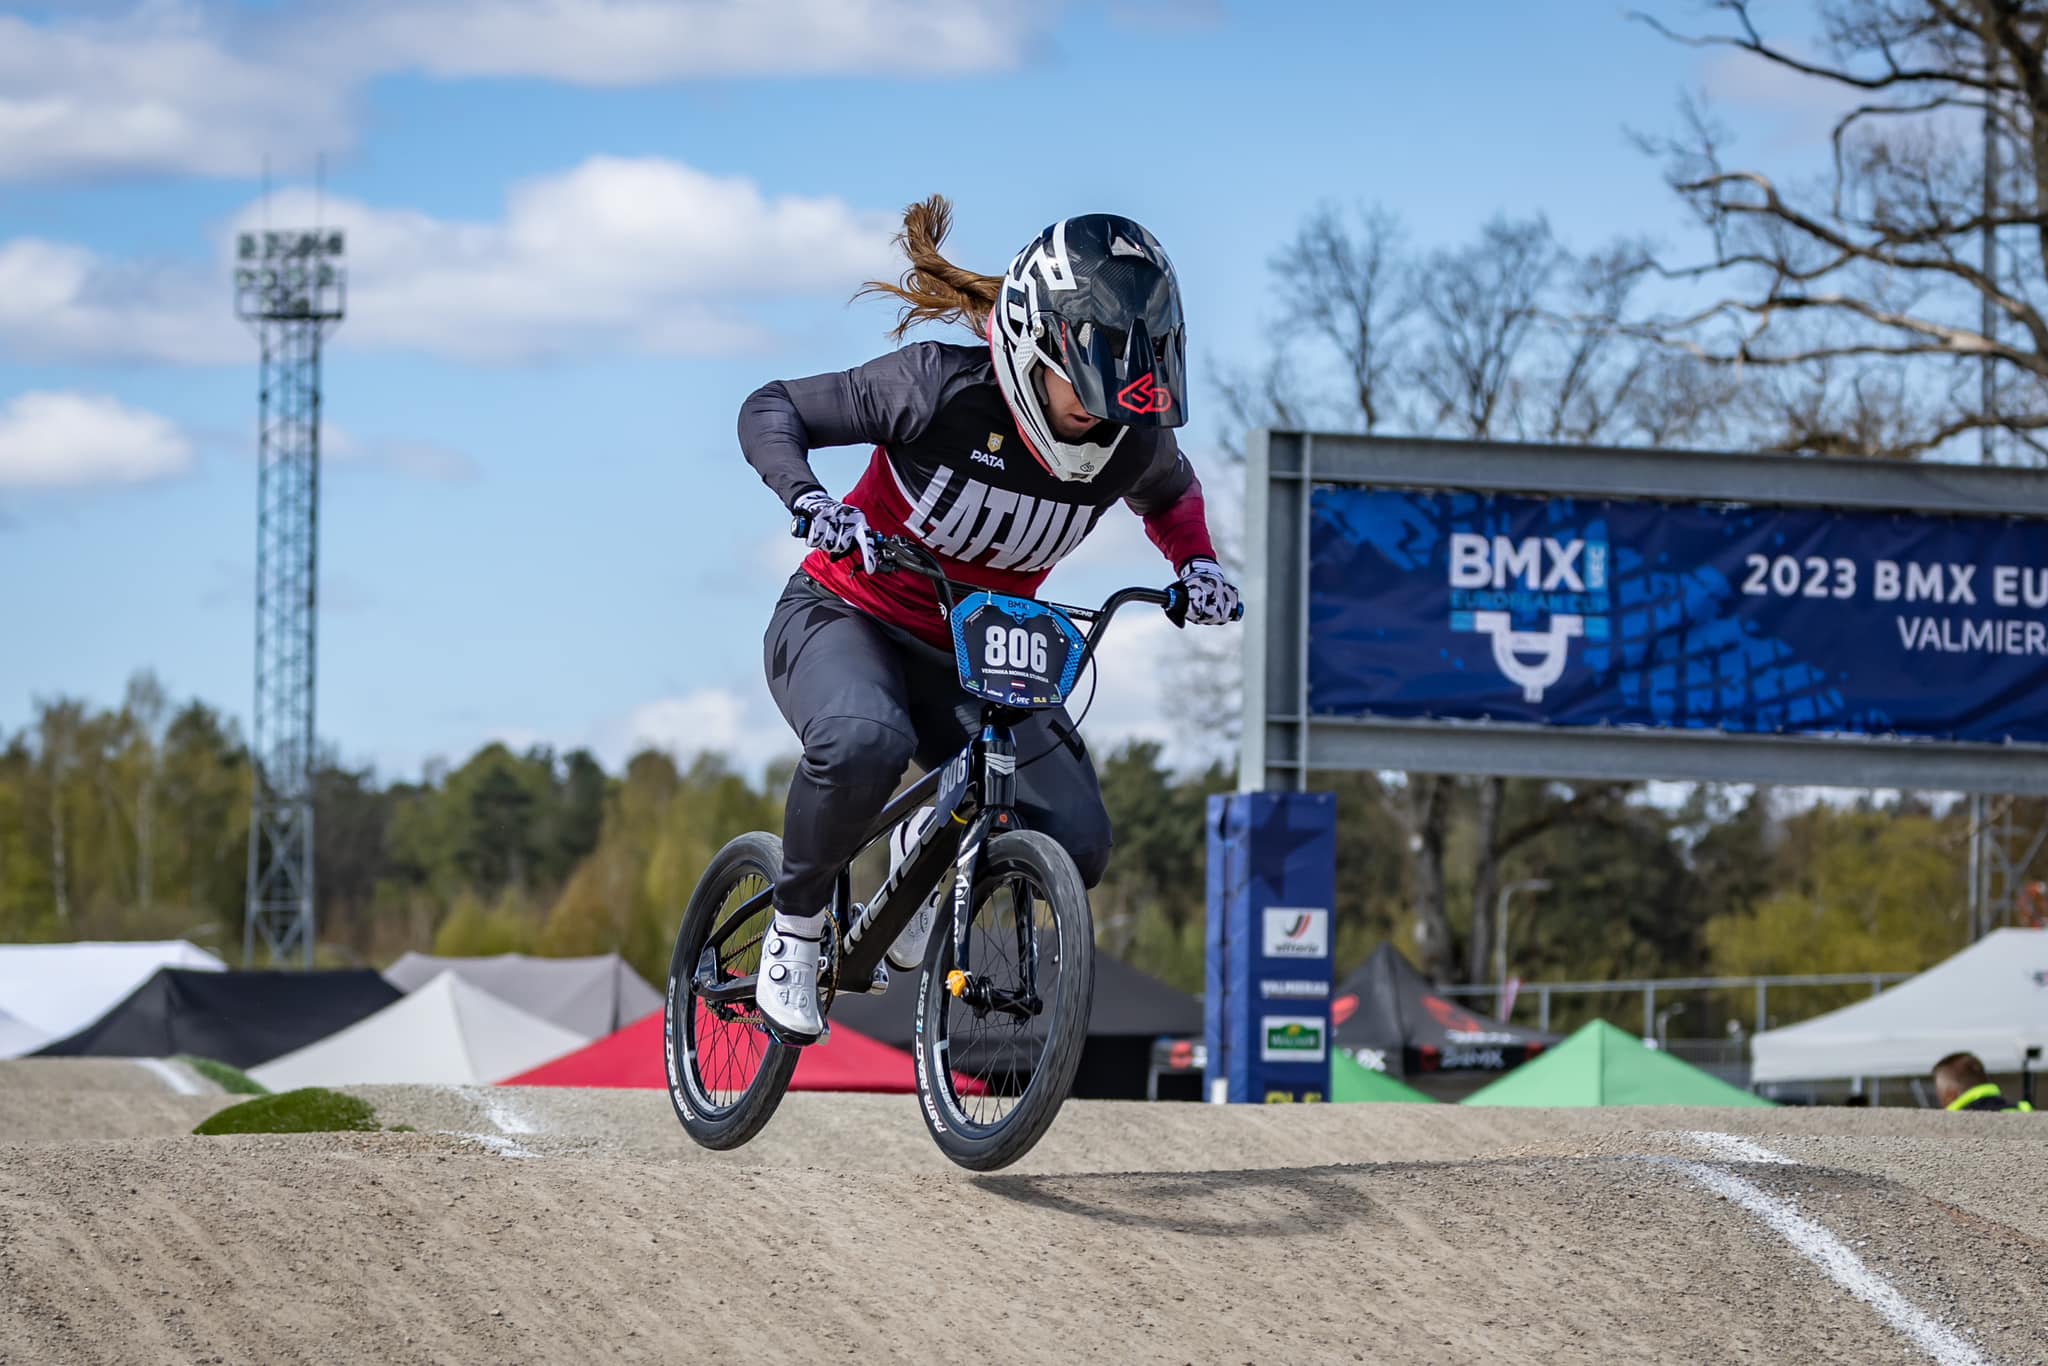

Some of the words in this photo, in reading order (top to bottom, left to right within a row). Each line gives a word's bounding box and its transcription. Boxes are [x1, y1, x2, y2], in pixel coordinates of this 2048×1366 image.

[970, 448, 1006, 471] PATA
[903, 464, 1097, 572] LATVIA
[1450, 532, 1586, 592] BMX
[1741, 554, 1858, 599] 2023
[1873, 560, 1978, 605] BMX
[1993, 566, 2048, 608] EU
[984, 625, 1049, 674] 806
[1896, 615, 2048, 655] VALMIER
[939, 747, 968, 801] 806
[923, 1092, 948, 1134] FASTR
